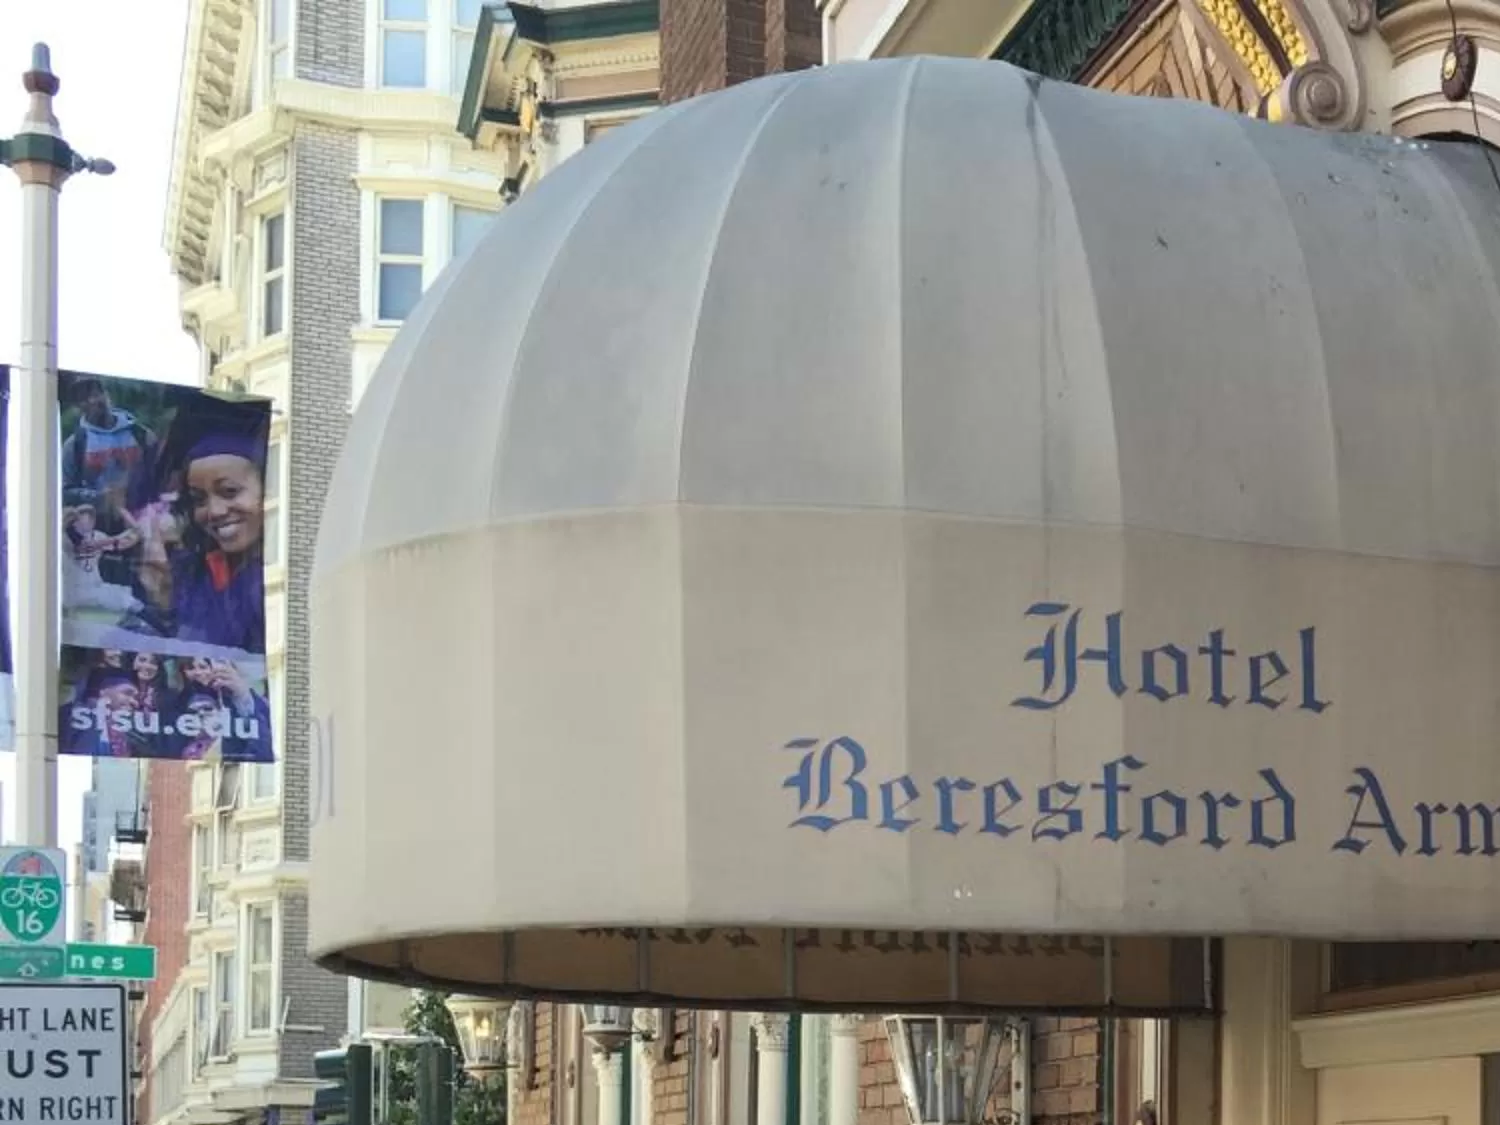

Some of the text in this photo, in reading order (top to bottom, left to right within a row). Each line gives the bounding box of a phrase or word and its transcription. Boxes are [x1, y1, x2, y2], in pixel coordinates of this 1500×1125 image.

[1009, 601, 1333, 714] Hotel
[70, 696, 260, 739] sfsu.edu
[782, 735, 1298, 851] Beresford
[16, 909, 44, 934] 16
[43, 1007, 115, 1032] LANE
[40, 1096, 118, 1121] RIGHT
